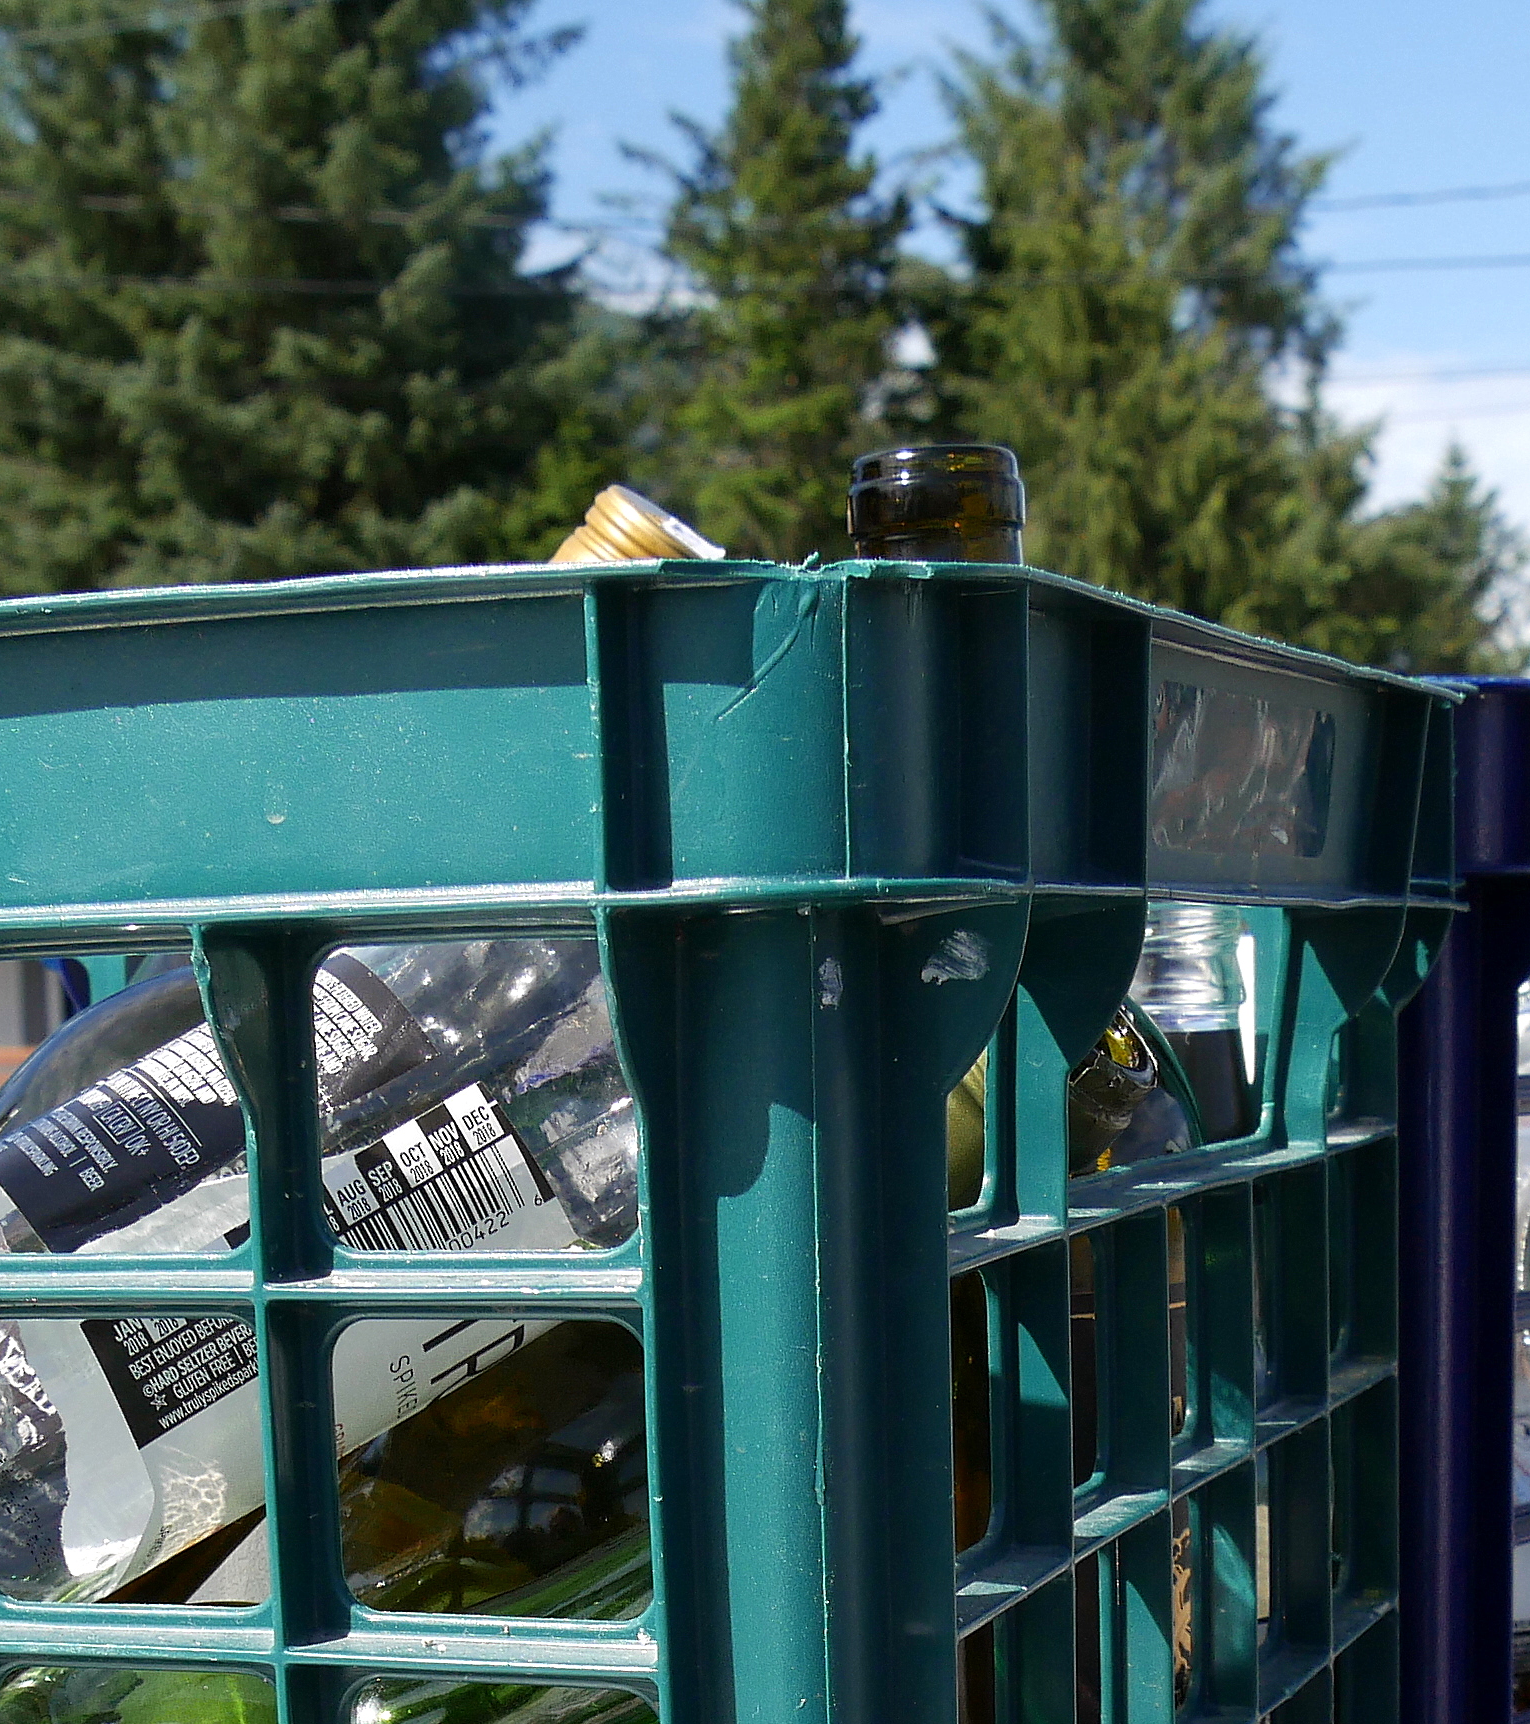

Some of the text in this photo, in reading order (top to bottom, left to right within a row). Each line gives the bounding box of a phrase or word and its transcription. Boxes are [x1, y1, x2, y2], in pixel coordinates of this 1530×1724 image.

[78, 1165, 105, 1193] BEER
[337, 1106, 490, 1207] AUG SEP OCT NOV DEC
[347, 1202, 371, 1221] 2018
[378, 1178, 403, 1201] 2018
[410, 1161, 434, 1183] 2018
[439, 1142, 465, 1166] 2018
[472, 1123, 497, 1146] 2018
[114, 1318, 143, 1343] JAN
[123, 1331, 149, 1357] 2018
[128, 1356, 157, 1381] BEST
[153, 1332, 197, 1368] ENJOYED
[172, 1366, 211, 1400] GLUTEN
[208, 1352, 237, 1381] FREE
[178, 1343, 220, 1381] SELTZER
[158, 1365, 259, 1430] www.trulyspikedspark
[390, 1354, 418, 1420] SPIKE
